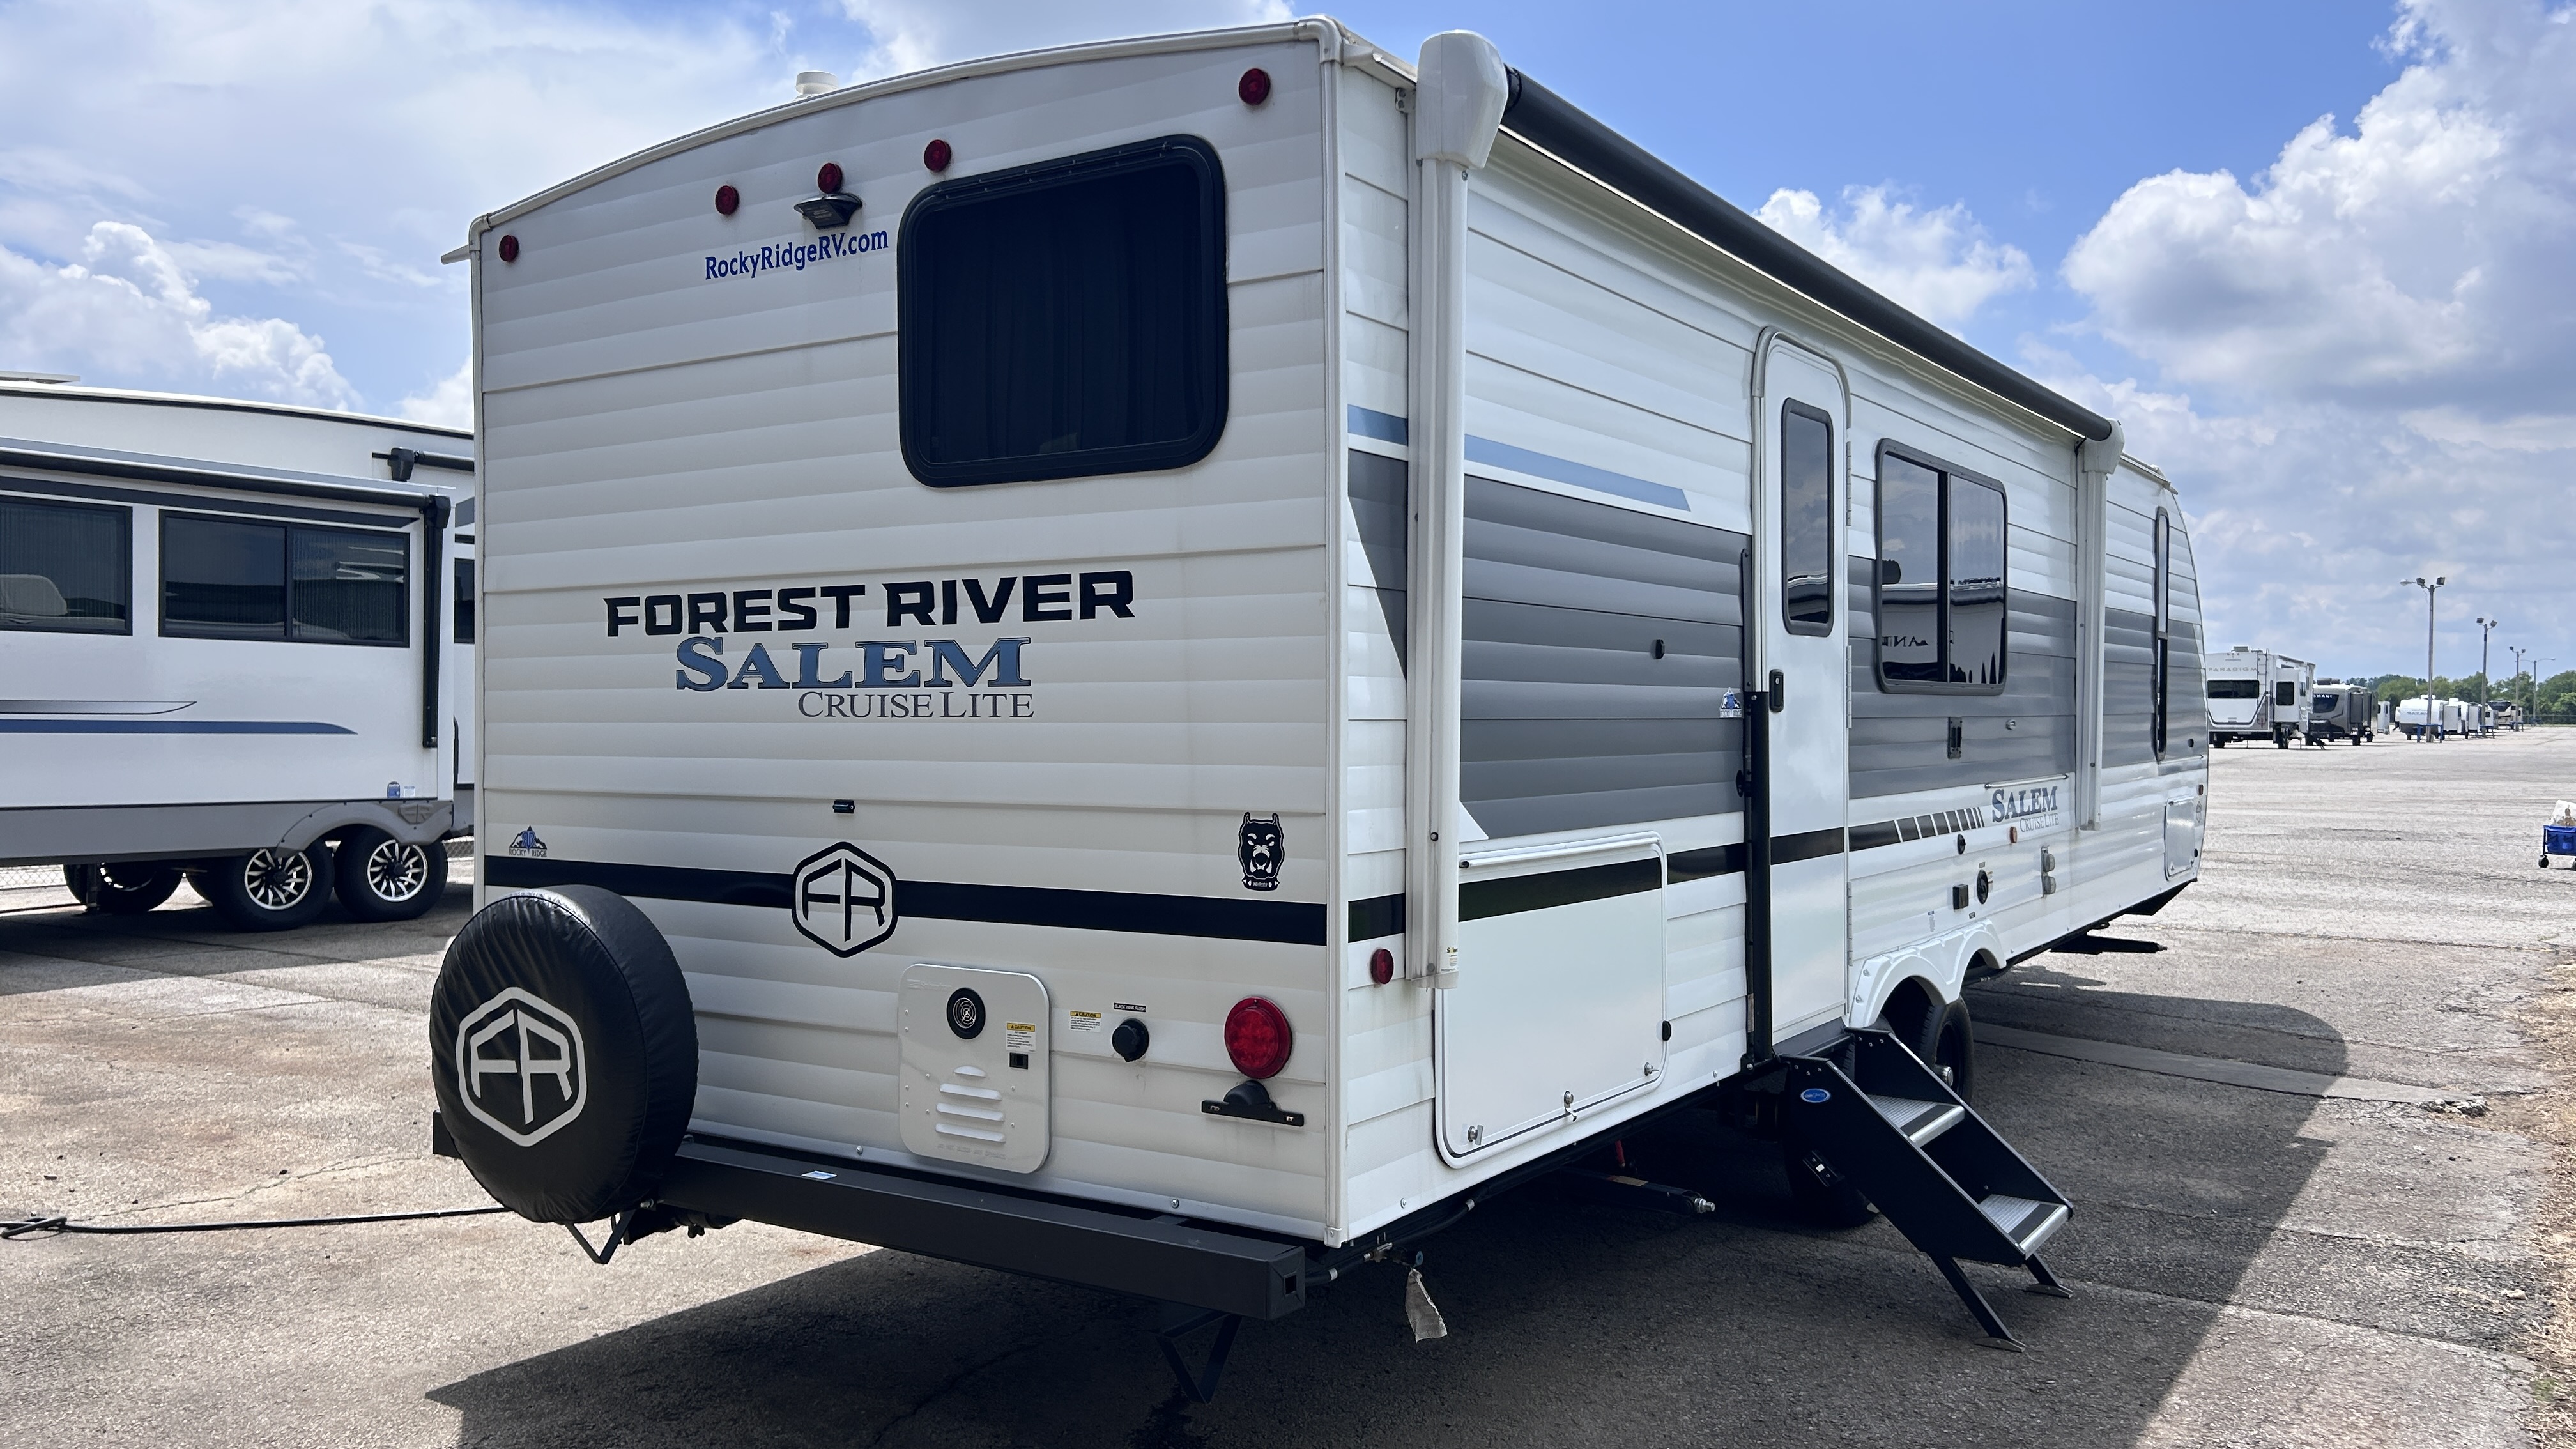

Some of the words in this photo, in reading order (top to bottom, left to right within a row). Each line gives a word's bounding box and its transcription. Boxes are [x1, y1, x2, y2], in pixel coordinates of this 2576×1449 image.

[705, 230, 889, 280] RockyRidgeRV.com
[603, 584, 866, 637] FOREST
[882, 570, 1135, 627] RIVER
[676, 636, 1031, 691] SALEM
[1991, 786, 2058, 823] SALEM
[509, 848, 526, 857] ROCKY
[532, 849, 548, 858] RIDGE
